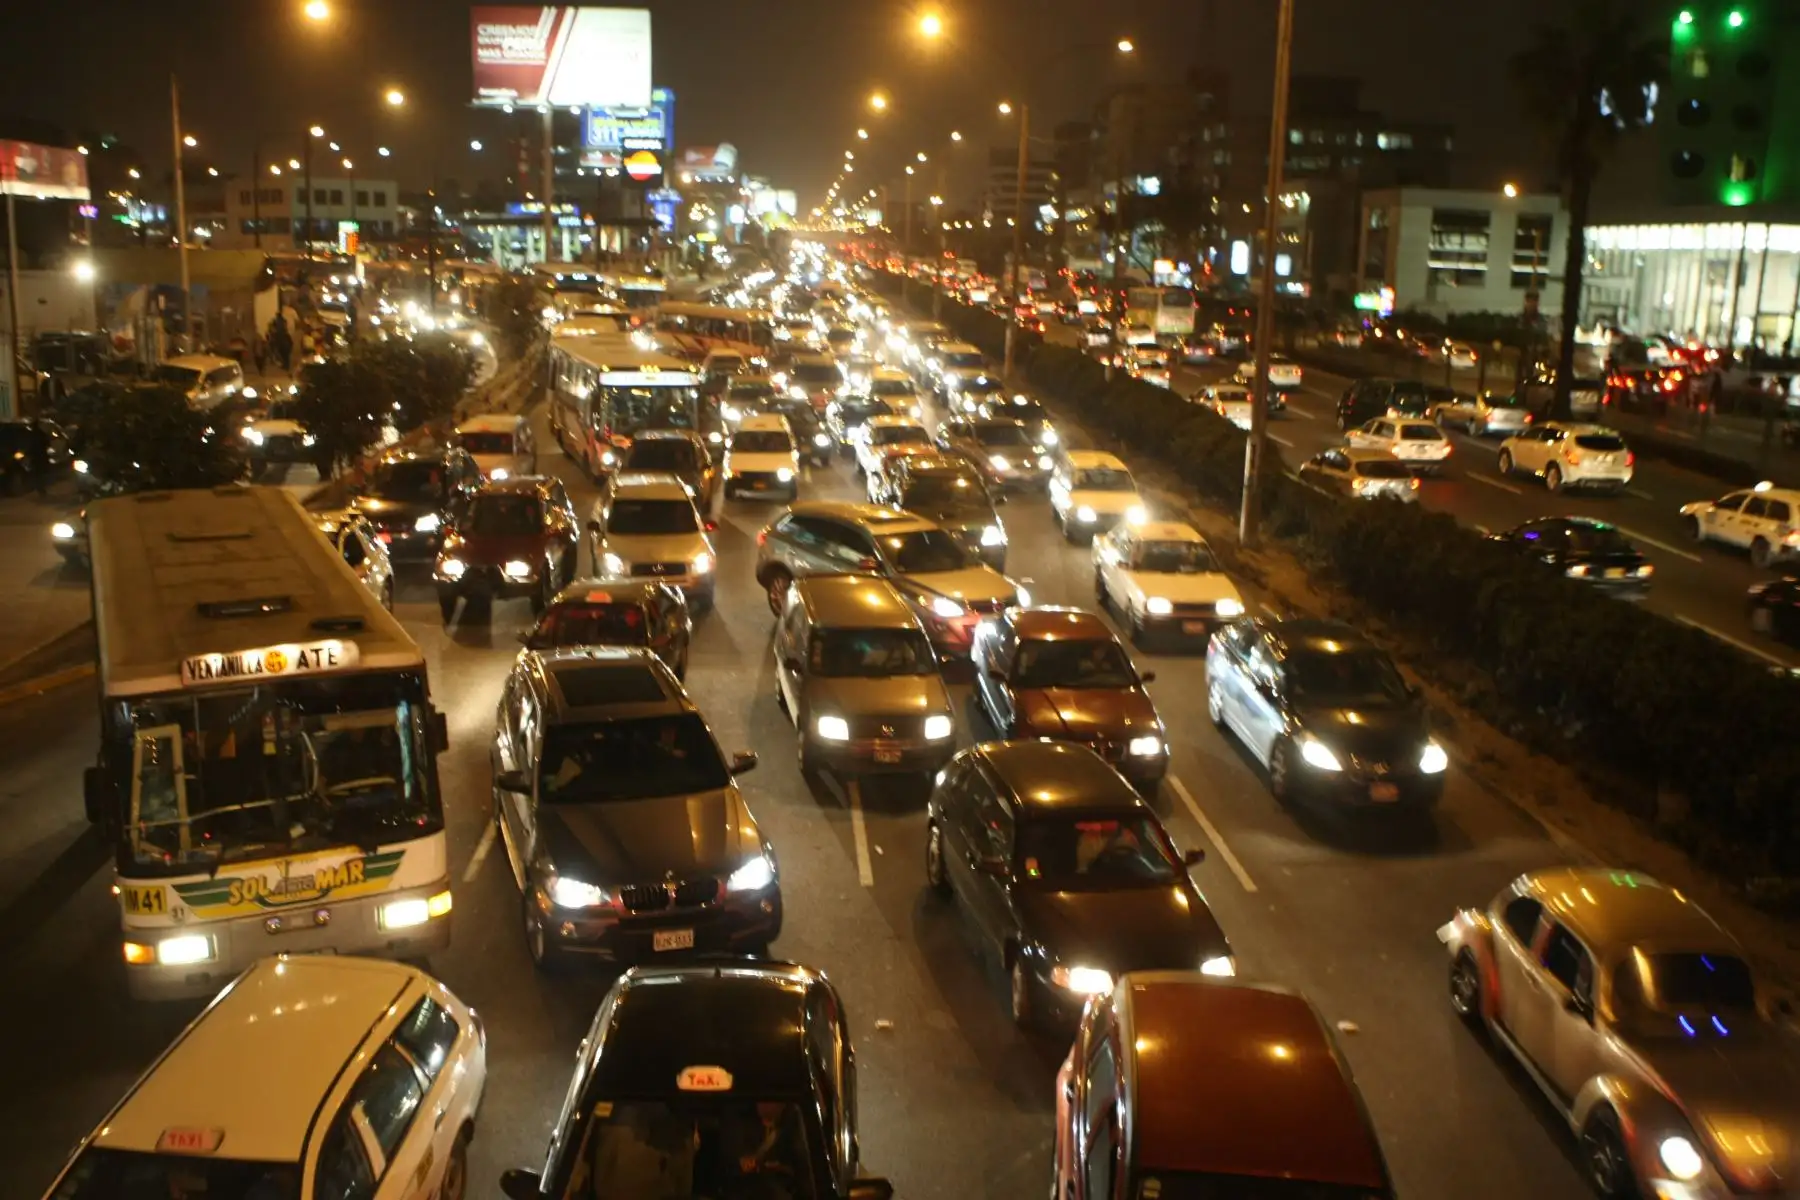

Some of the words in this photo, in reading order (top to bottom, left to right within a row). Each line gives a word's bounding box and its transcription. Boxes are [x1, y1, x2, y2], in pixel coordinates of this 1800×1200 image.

[296, 648, 338, 669] ATE
[228, 874, 271, 906] SOL
[315, 858, 367, 891] MAR
